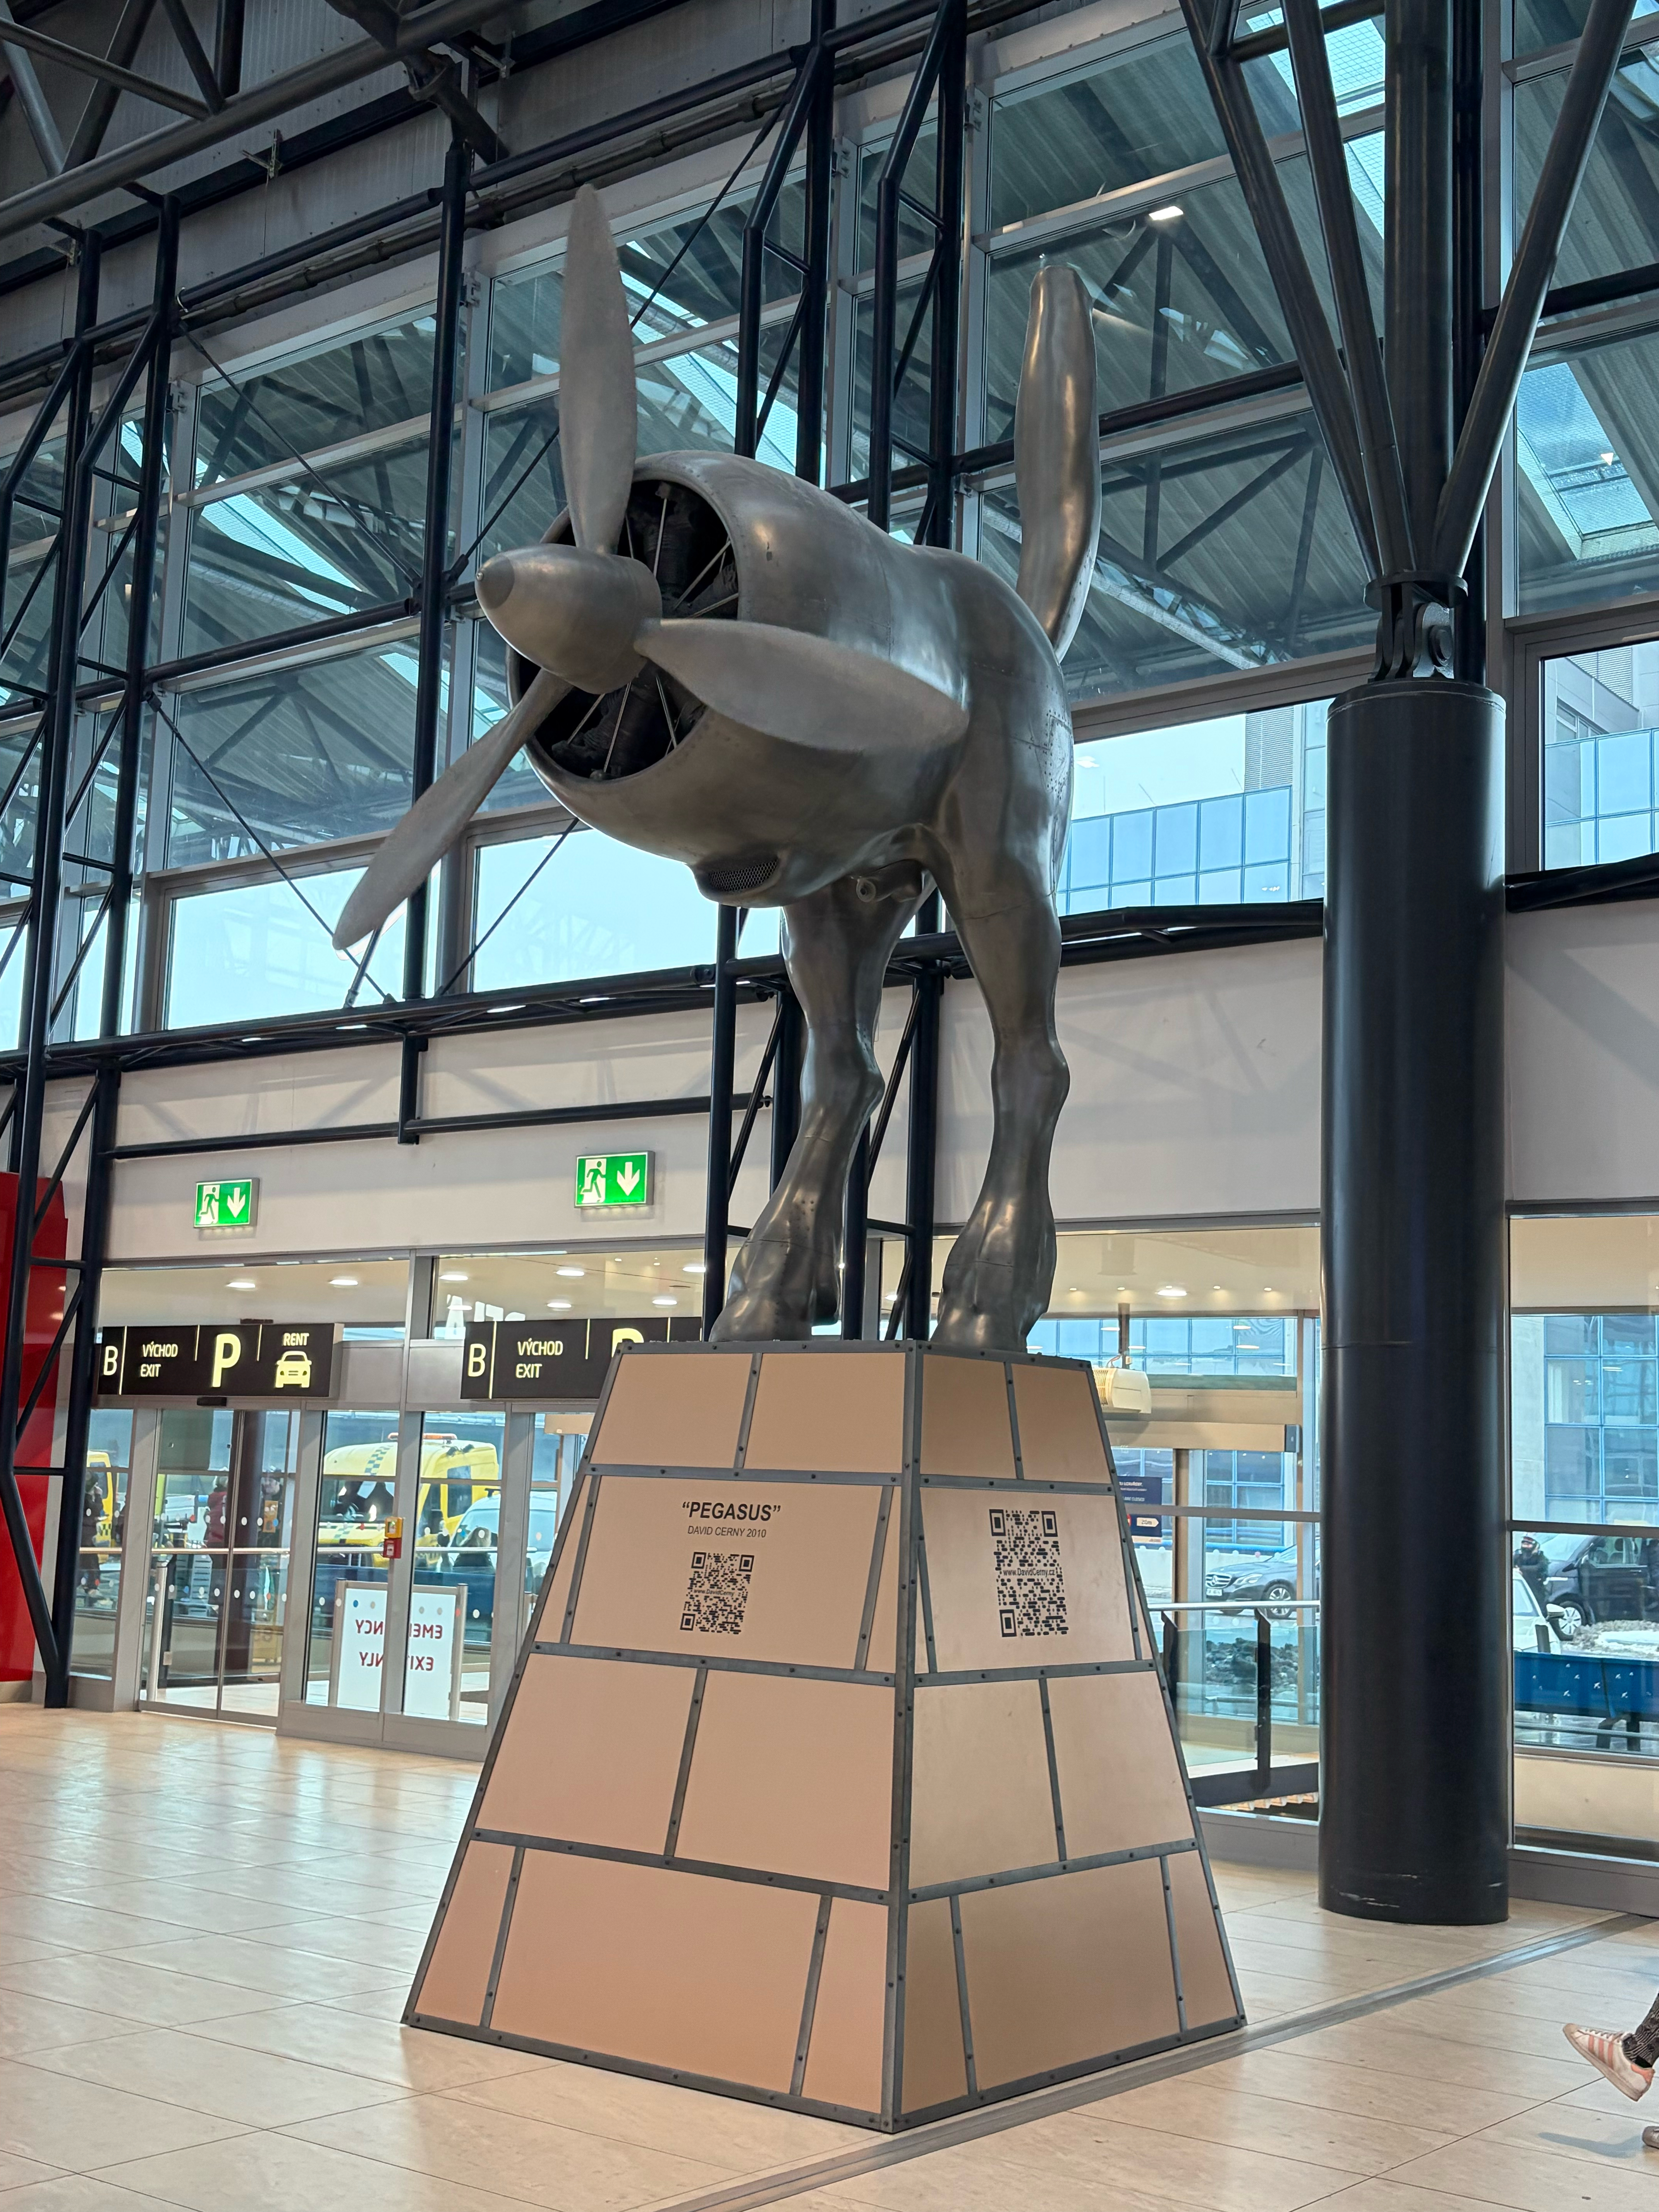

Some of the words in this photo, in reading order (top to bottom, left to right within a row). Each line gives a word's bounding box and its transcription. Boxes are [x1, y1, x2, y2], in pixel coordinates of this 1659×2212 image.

[283, 1333, 309, 1346] RENT
[517, 1338, 563, 1356] VÝCHOD
[142, 1341, 178, 1357] VÝCHOD
[103, 1345, 118, 1376] B
[213, 1333, 241, 1388] P
[468, 1343, 486, 1377] B
[140, 1364, 161, 1377] EXIT
[516, 1363, 542, 1378] EXIT
[687, 1525, 713, 1535] DAVID
[714, 1527, 745, 1537] CERNY
[746, 1528, 767, 1538] 2010
[1003, 1568, 1055, 1577] www.DavidCerny.cz
